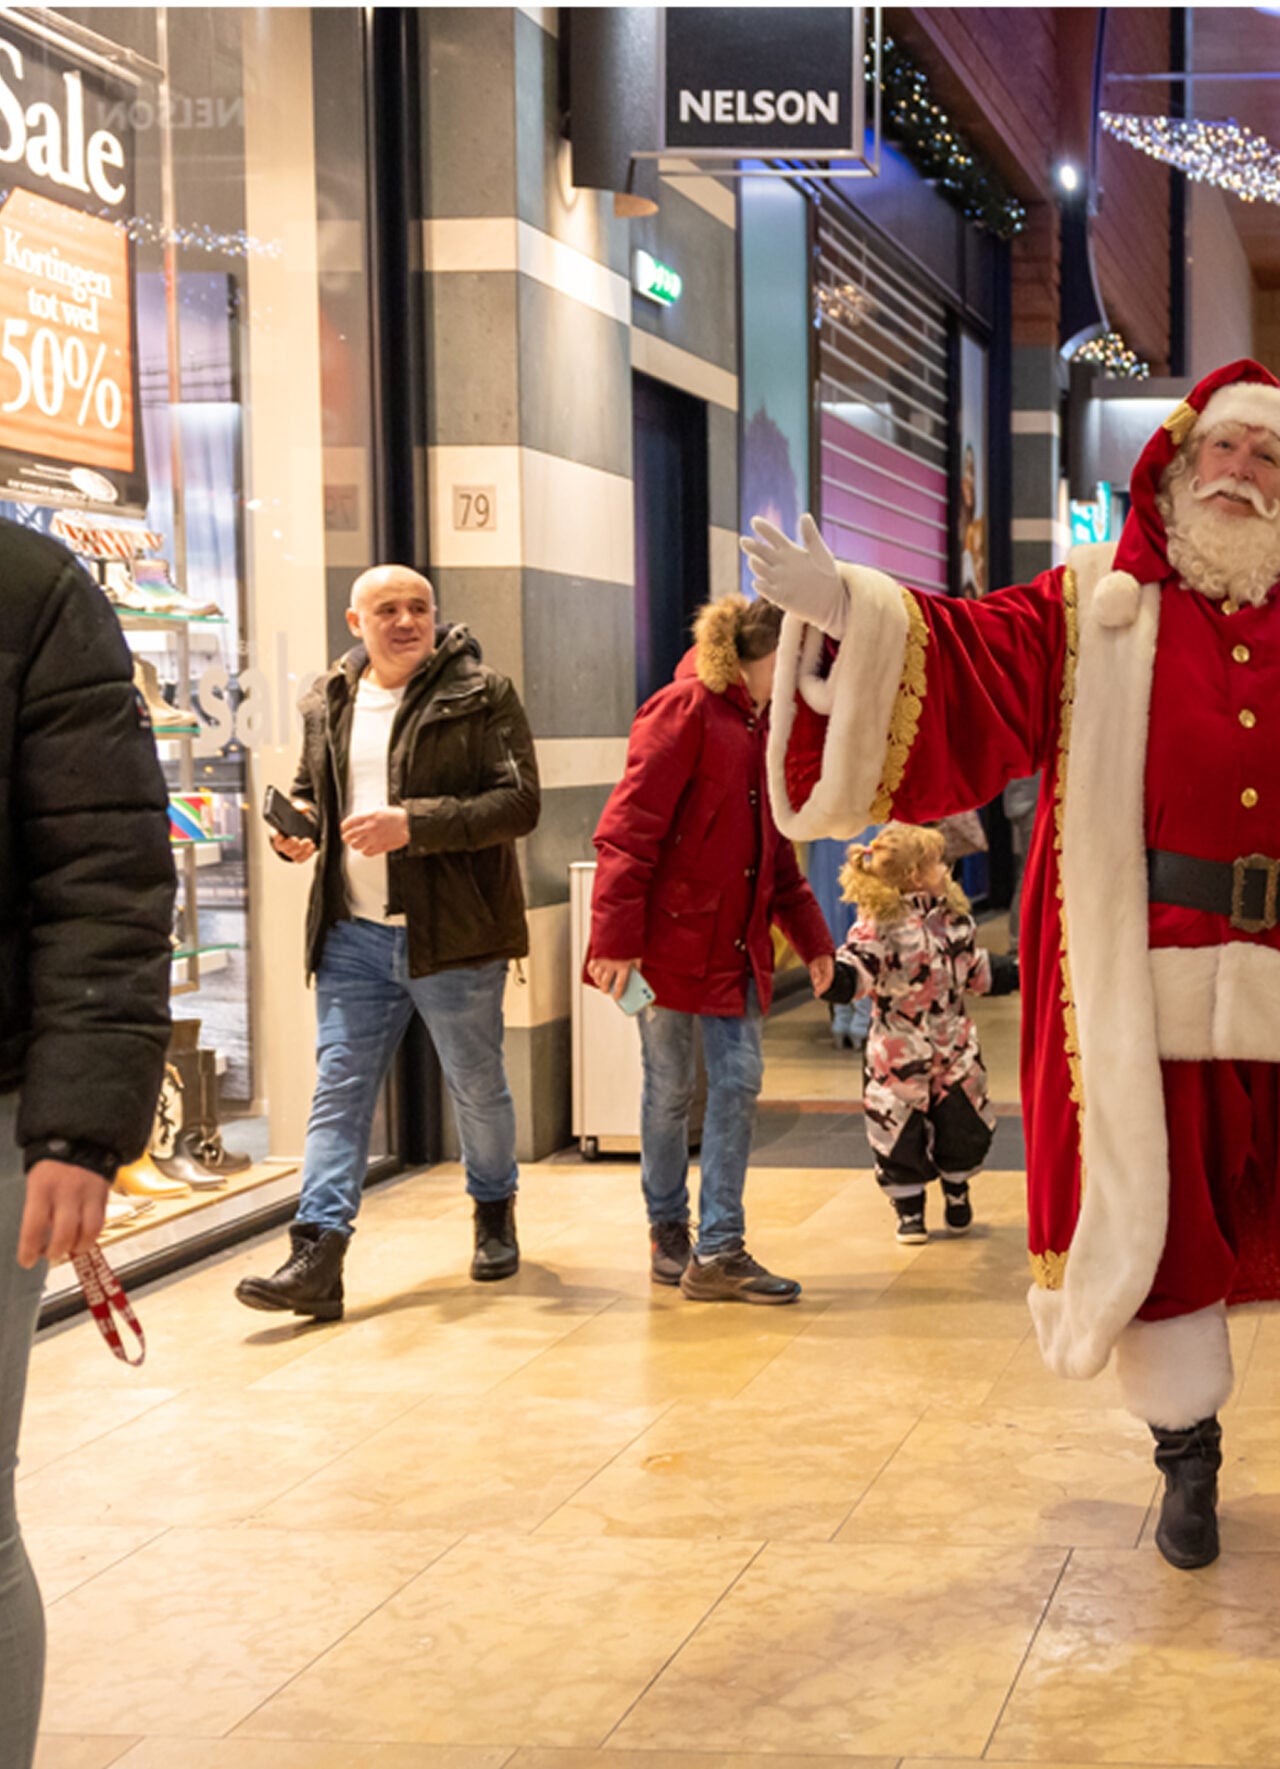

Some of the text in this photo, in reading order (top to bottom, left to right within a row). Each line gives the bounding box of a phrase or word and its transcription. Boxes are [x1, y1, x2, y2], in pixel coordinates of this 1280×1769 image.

[0, 38, 126, 205] Sale
[679, 89, 839, 125] NELSON
[3, 226, 113, 303] Kortingen
[28, 287, 99, 334] tot wel
[2, 318, 122, 430] 50%
[459, 493, 489, 528] 79
